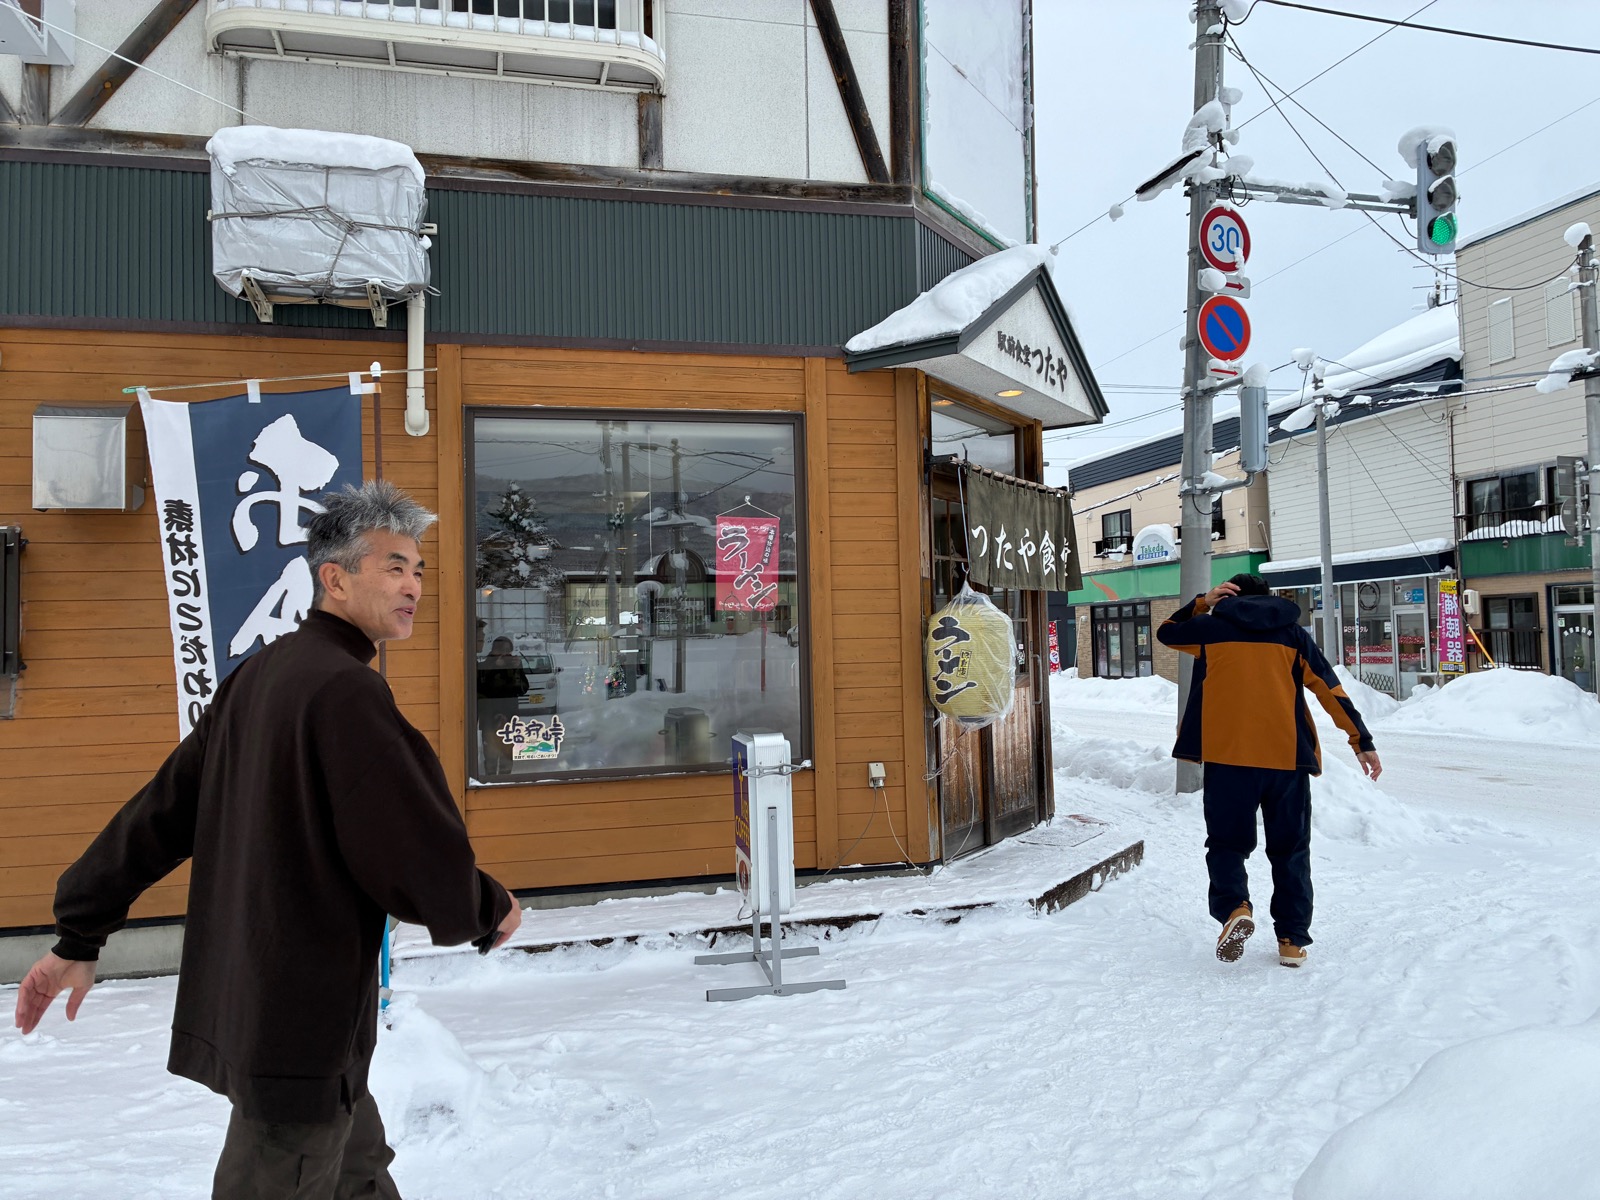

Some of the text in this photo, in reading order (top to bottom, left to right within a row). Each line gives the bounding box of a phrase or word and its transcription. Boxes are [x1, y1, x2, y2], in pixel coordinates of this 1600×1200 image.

[1212, 224, 1240, 254] 30
[1141, 543, 1164, 554] Takeda
[717, 526, 778, 609] ラーメン
[498, 716, 563, 752] 塩狩峠
